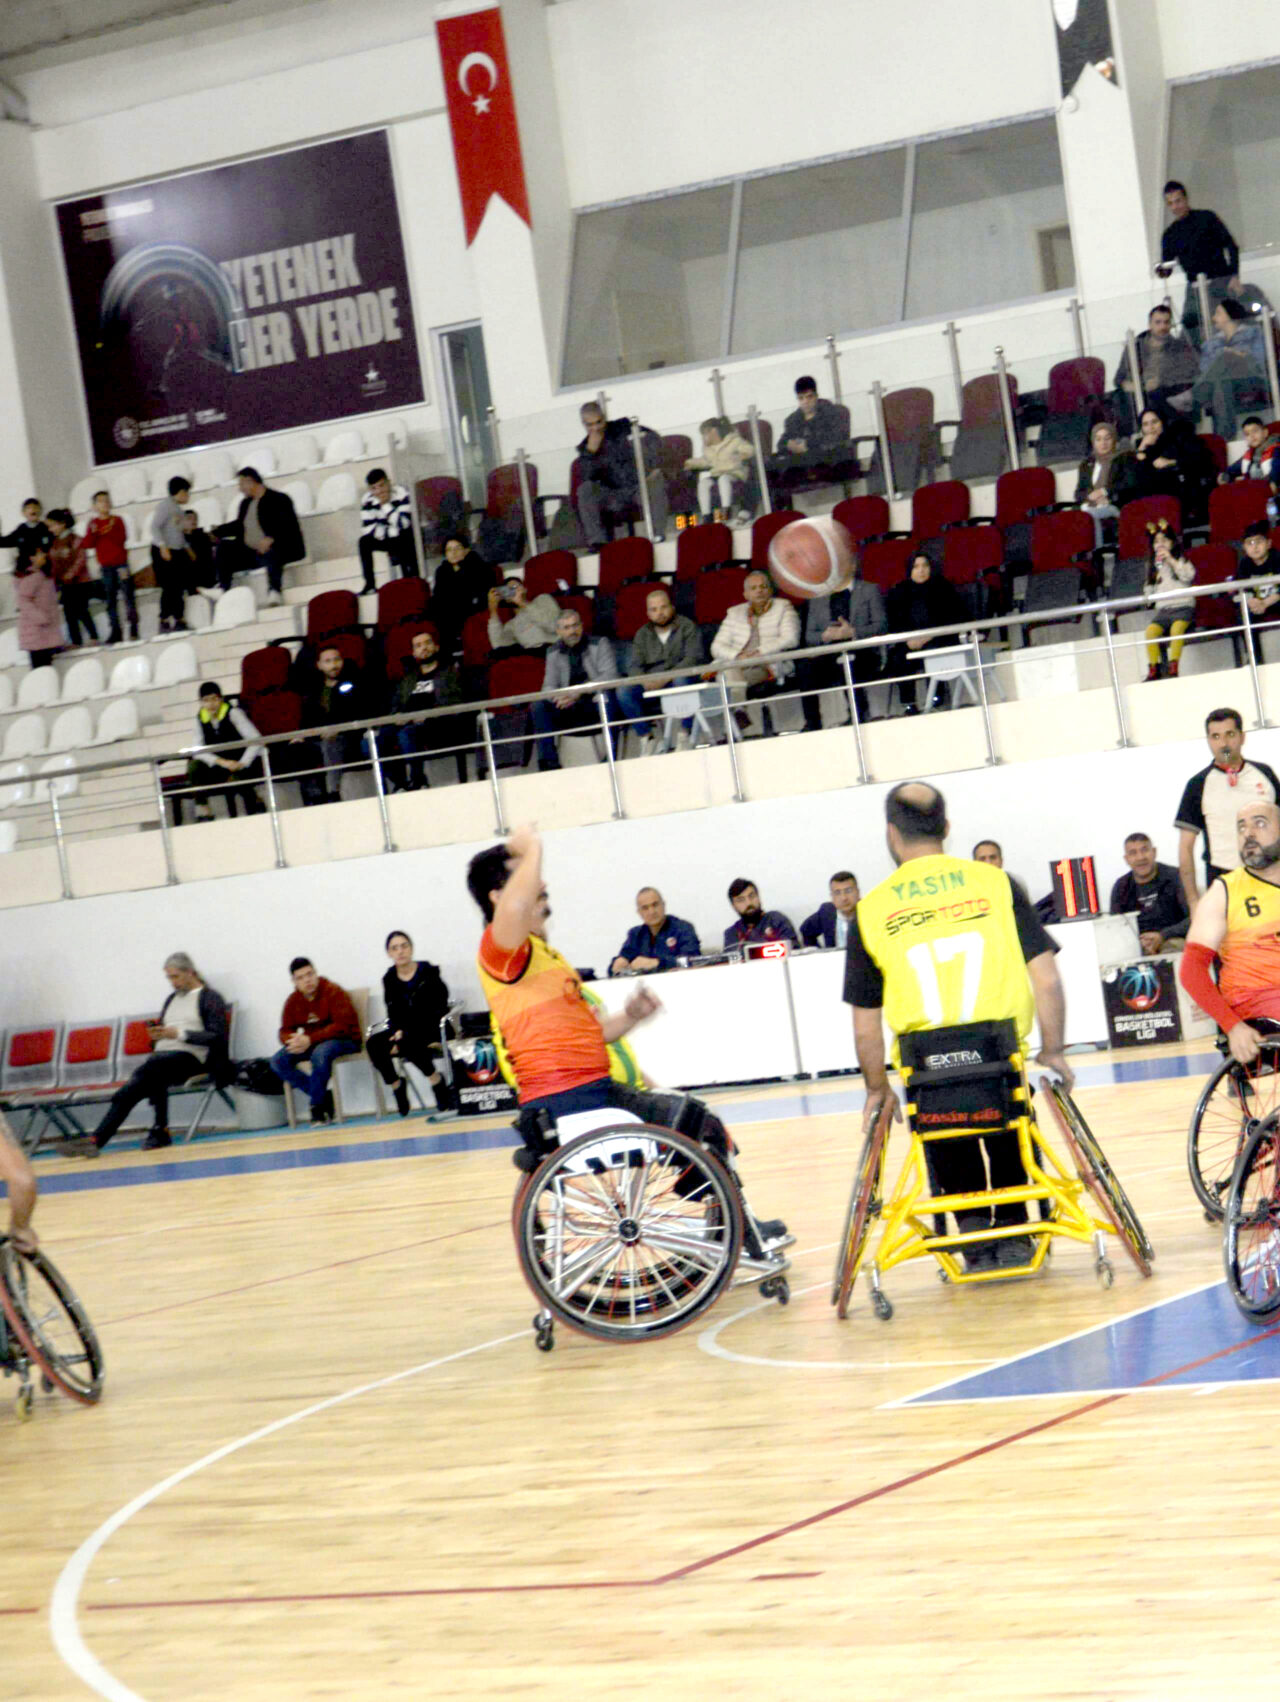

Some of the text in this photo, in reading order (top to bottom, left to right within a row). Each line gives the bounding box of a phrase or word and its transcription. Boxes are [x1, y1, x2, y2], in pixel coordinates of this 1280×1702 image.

[219, 233, 362, 312] YETENEK
[229, 286, 403, 374] HER YERDE
[1056, 856, 1098, 918] 11
[1244, 896, 1261, 917] 6
[907, 931, 985, 1026] 17
[1115, 1017, 1175, 1033] BASKETBOL
[927, 1050, 983, 1066] EXTRA
